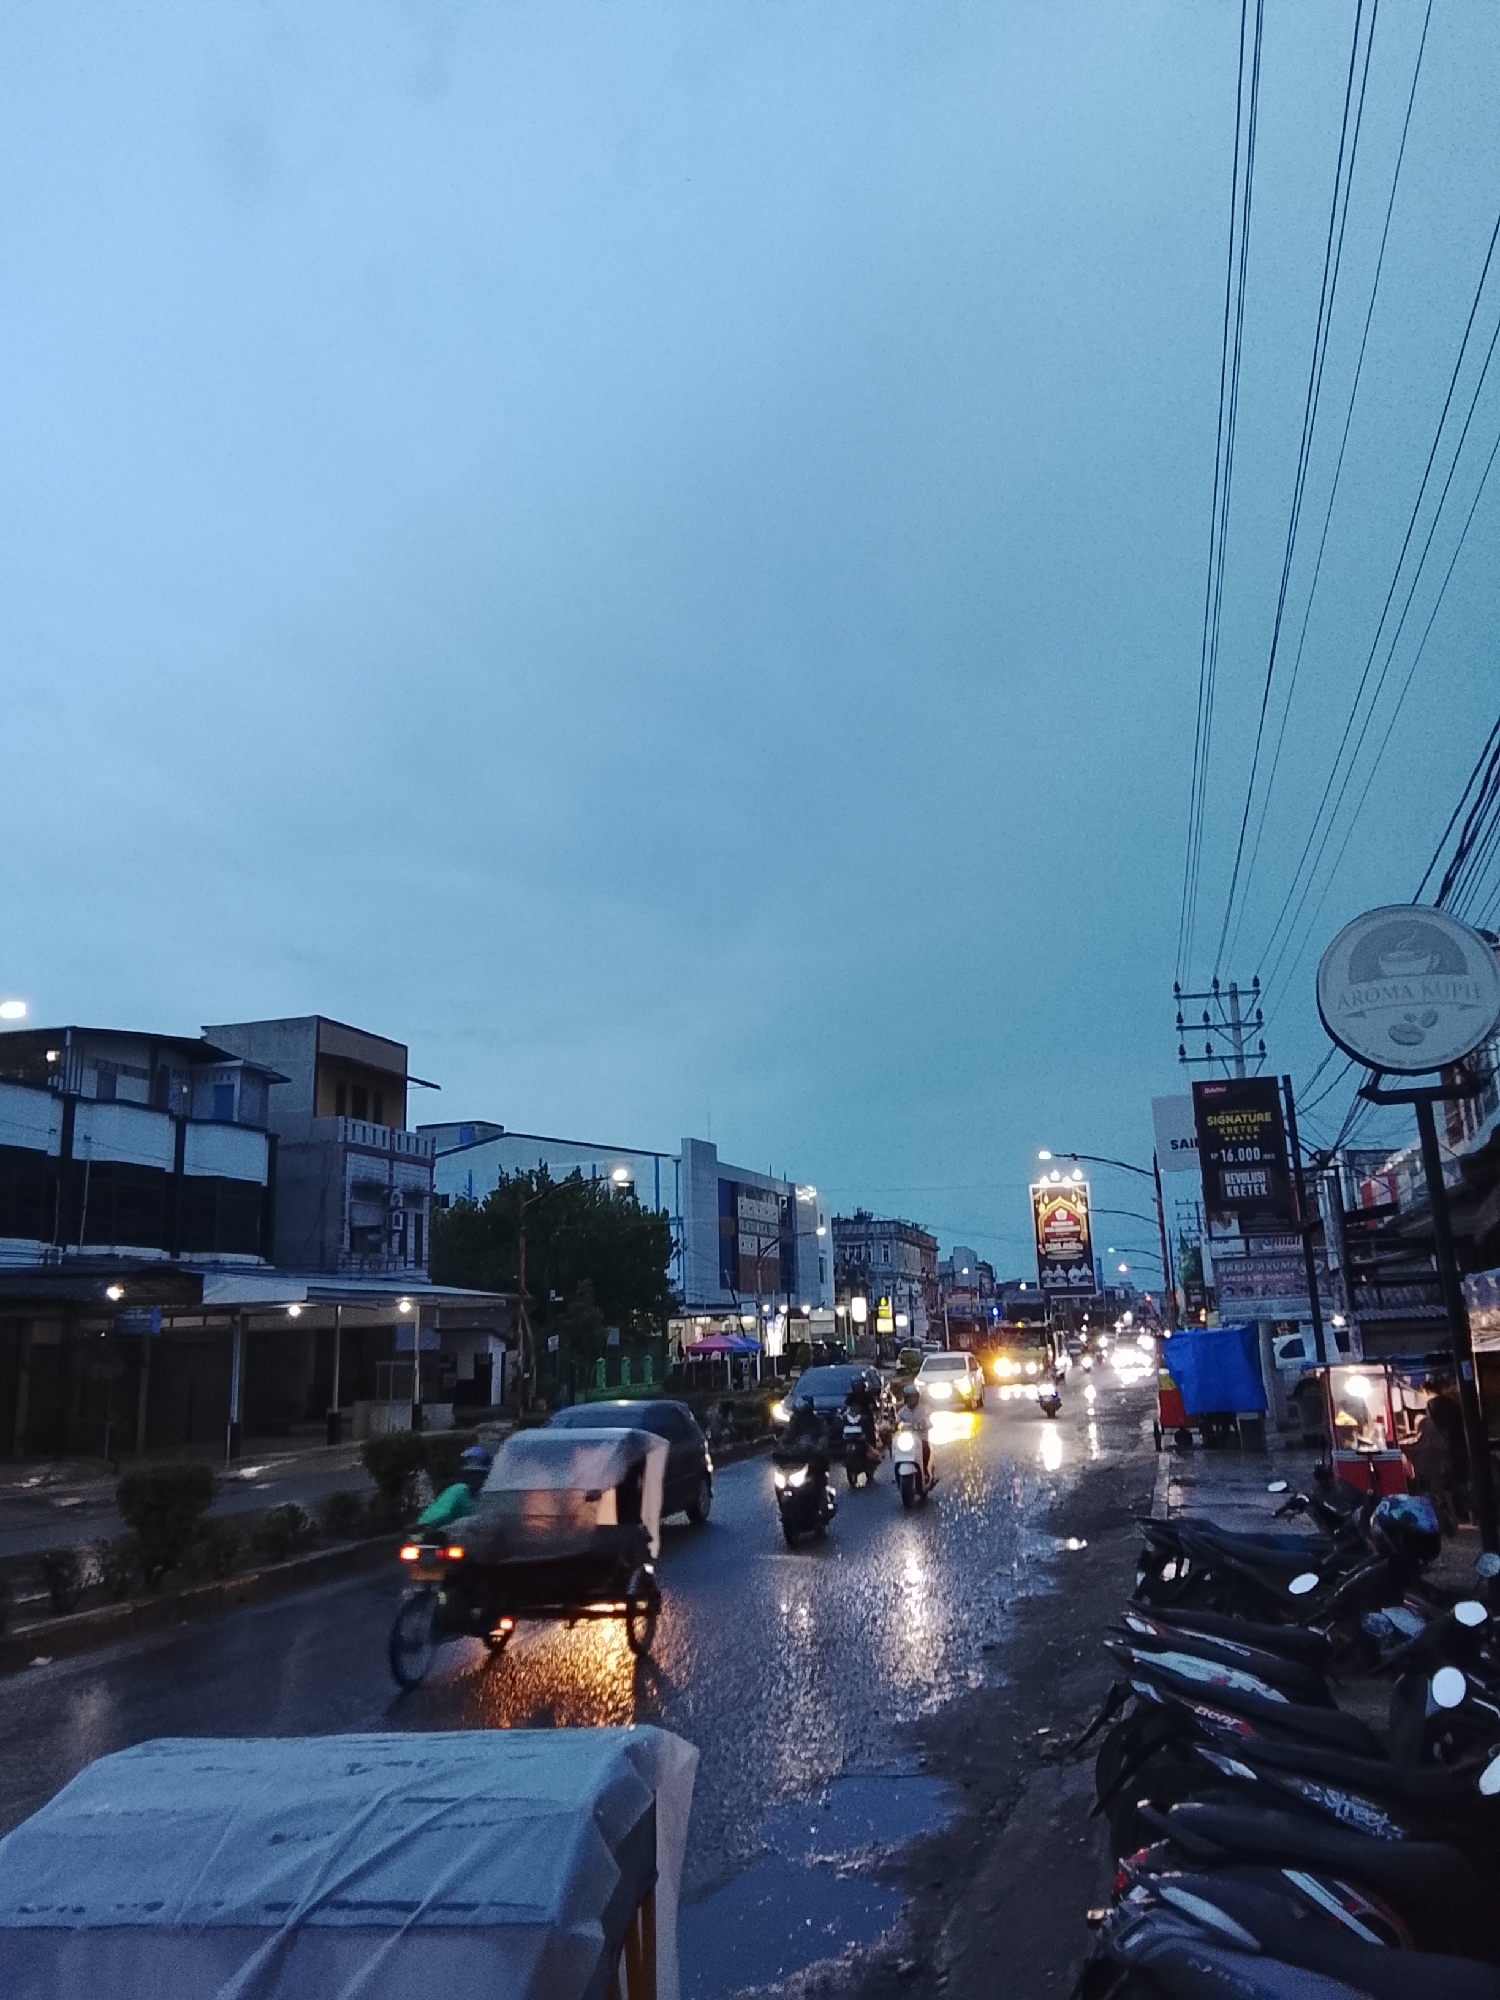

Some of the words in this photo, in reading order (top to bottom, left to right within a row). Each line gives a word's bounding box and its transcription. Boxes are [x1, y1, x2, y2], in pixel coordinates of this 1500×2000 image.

[1337, 984, 1415, 1011] AROMA
[1206, 1112, 1272, 1126] SIGNATURE
[1219, 1125, 1260, 1135] KRETEK
[1220, 1146, 1261, 1162] 16.000
[1224, 1171, 1266, 1185] REVOLUSI
[1226, 1184, 1268, 1197] KRETEK
